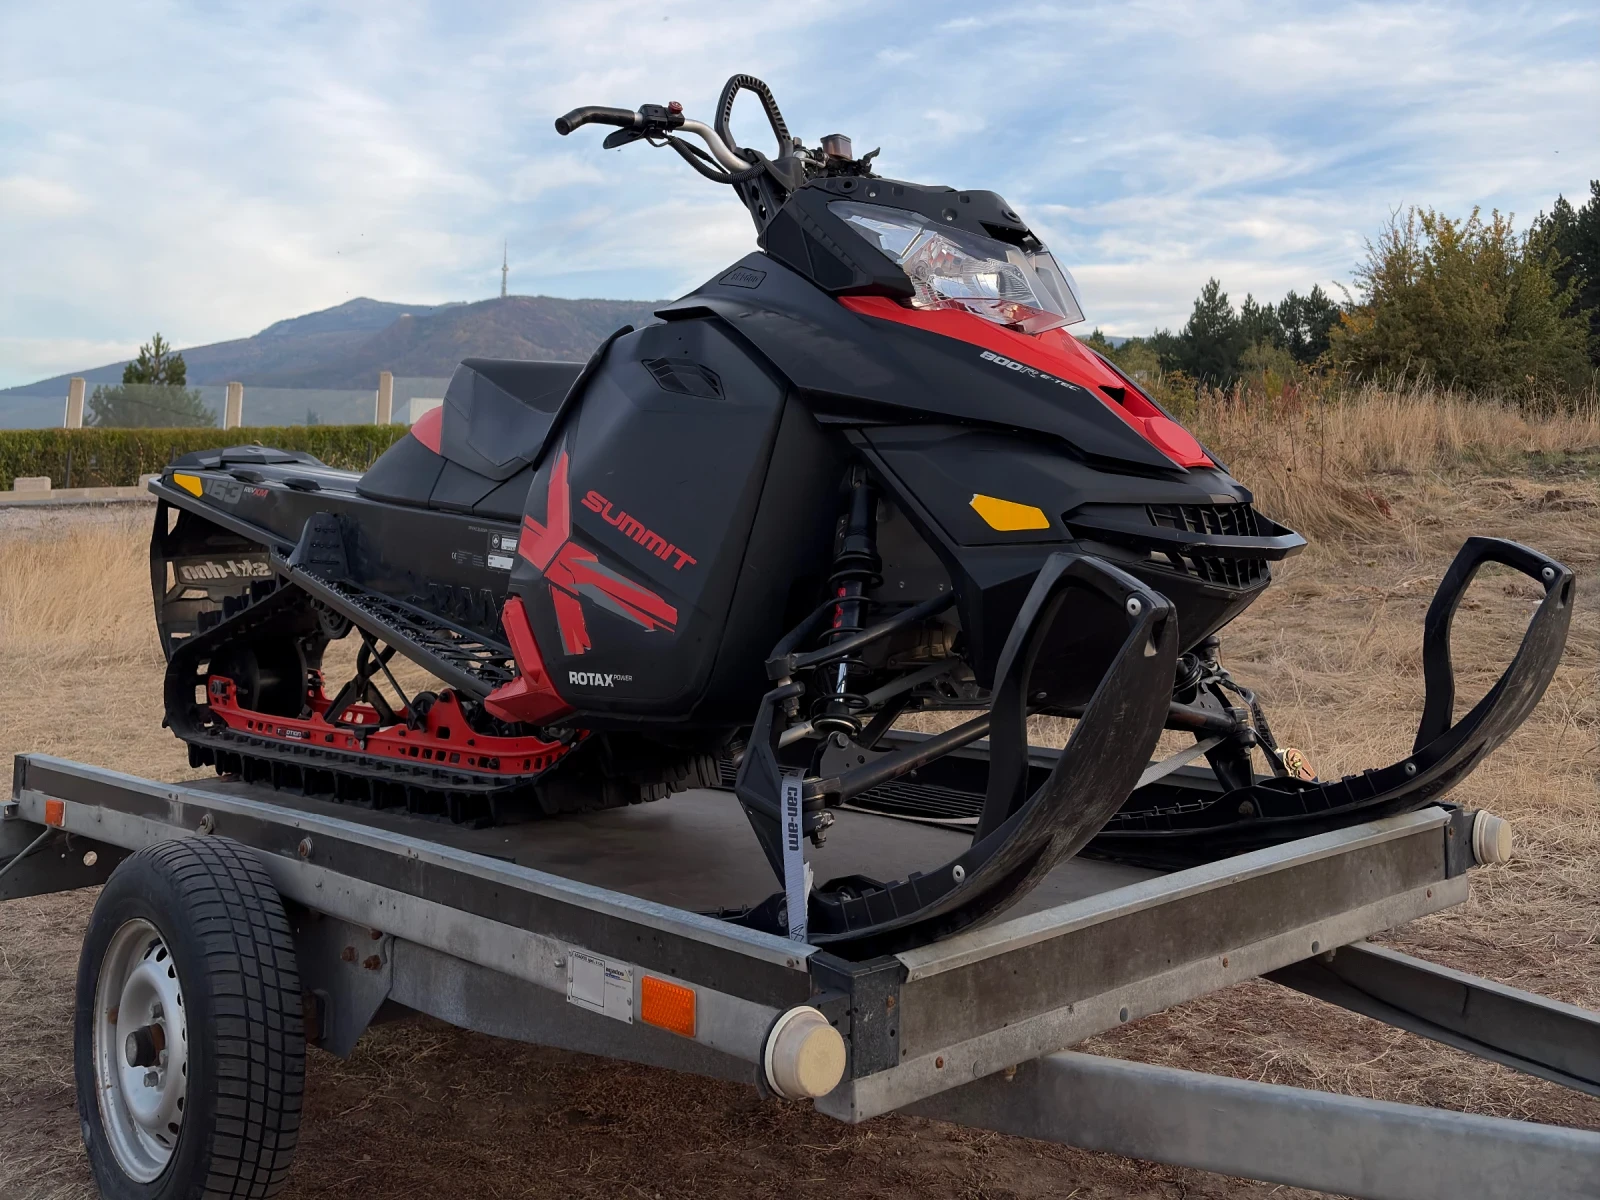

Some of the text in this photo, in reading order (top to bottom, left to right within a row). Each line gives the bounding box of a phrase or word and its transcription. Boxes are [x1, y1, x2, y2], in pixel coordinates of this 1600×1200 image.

[980, 350, 1039, 378] 800R
[205, 479, 245, 505] 163
[581, 490, 697, 571] SUMMIT
[568, 671, 614, 687] ROTAX
[787, 786, 800, 851] can-am
